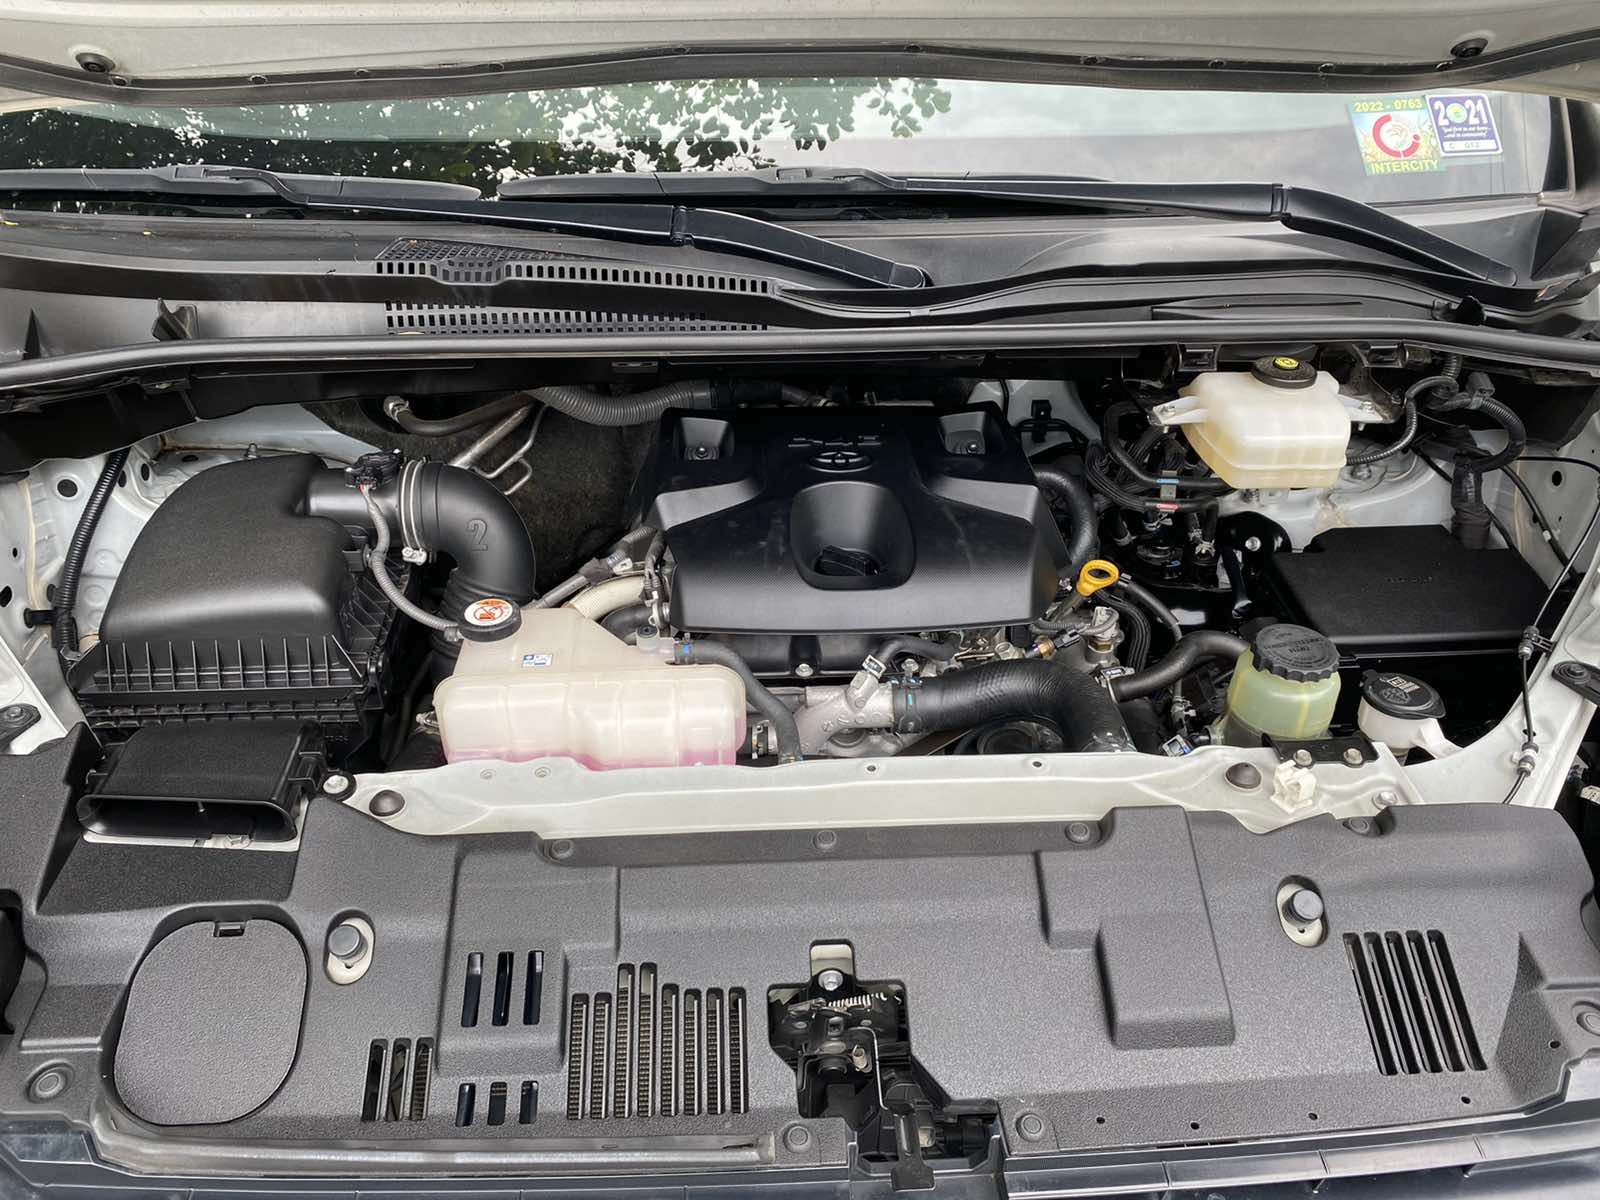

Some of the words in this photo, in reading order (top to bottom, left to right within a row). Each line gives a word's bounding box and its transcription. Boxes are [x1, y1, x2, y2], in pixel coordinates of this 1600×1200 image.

[1354, 102, 1384, 112] 2022
[1434, 99, 1488, 126] 2021
[1371, 160, 1438, 174] INTERCITY
[466, 518, 488, 551] 2
